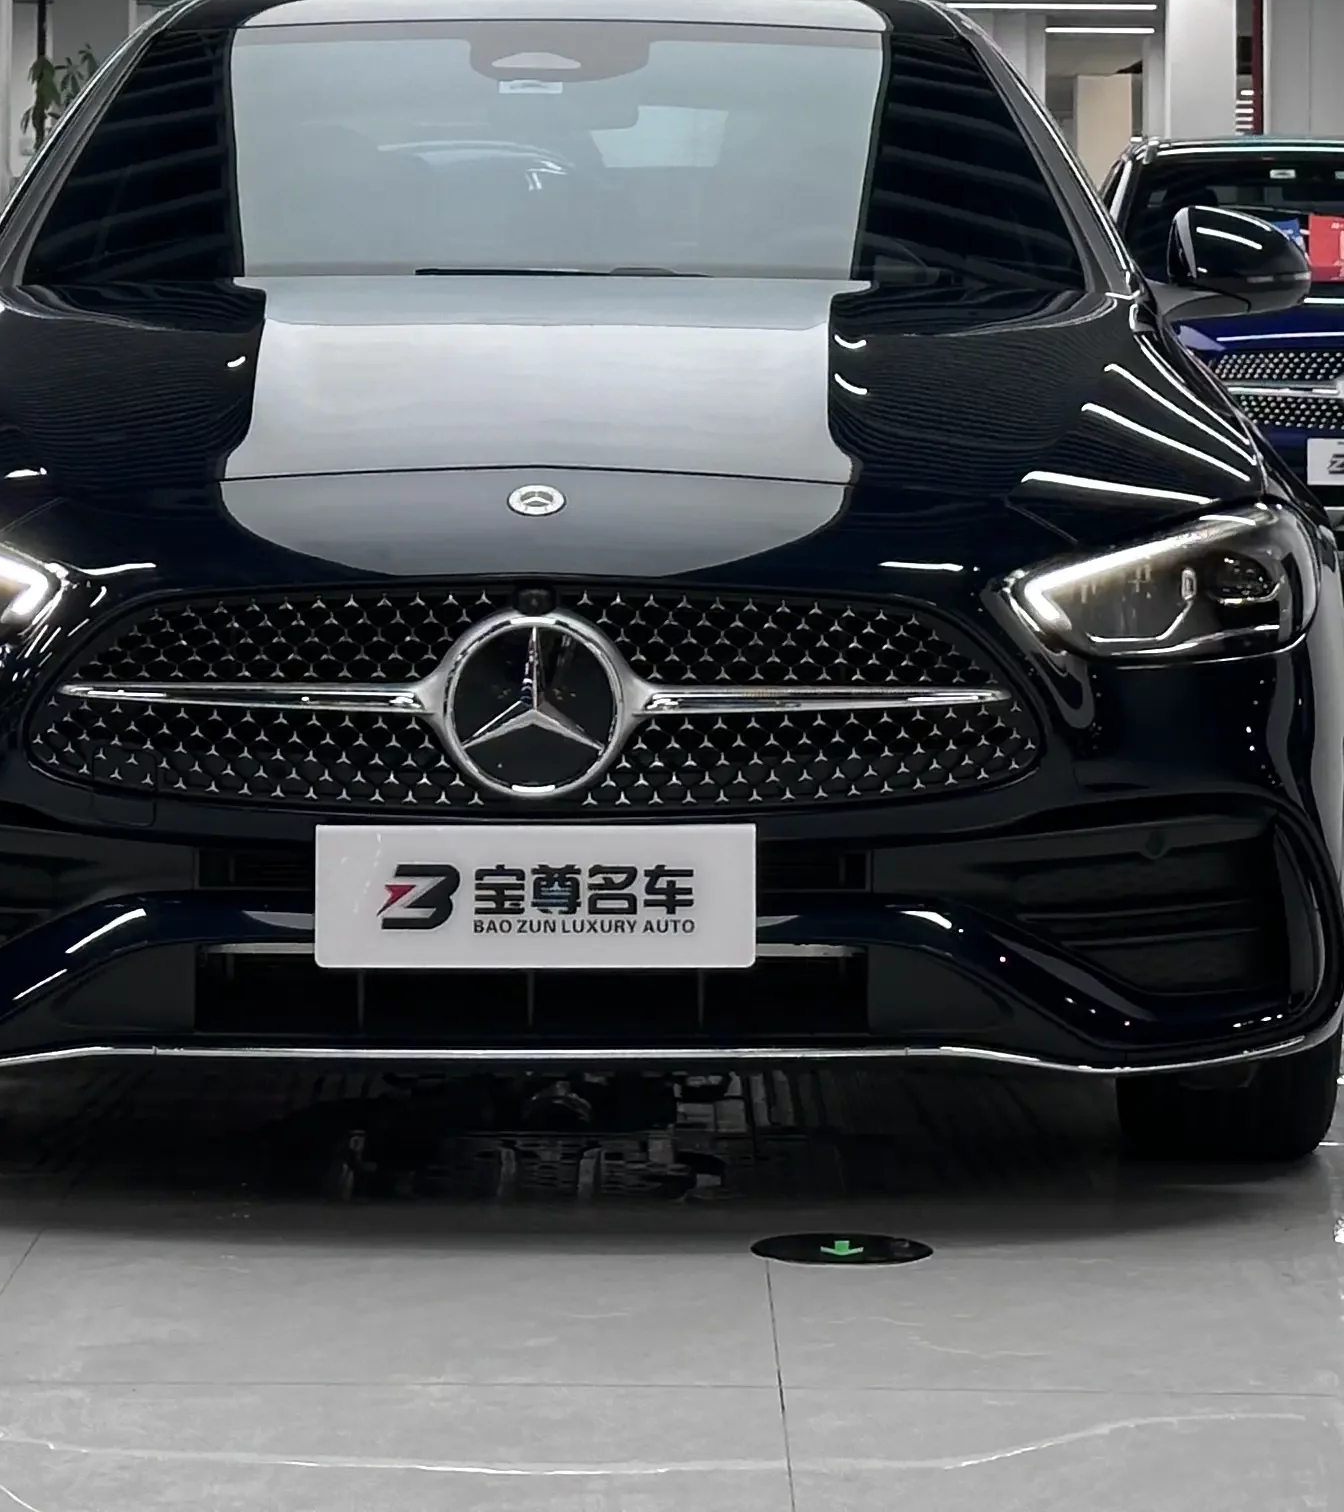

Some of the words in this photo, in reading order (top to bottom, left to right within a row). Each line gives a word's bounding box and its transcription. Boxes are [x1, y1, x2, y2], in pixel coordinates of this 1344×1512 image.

[474, 864, 695, 915] 宝尊名车
[473, 919, 513, 934] BAO
[516, 919, 557, 934] ZUN
[561, 919, 638, 934] LUXURY
[642, 919, 696, 934] AUTO
